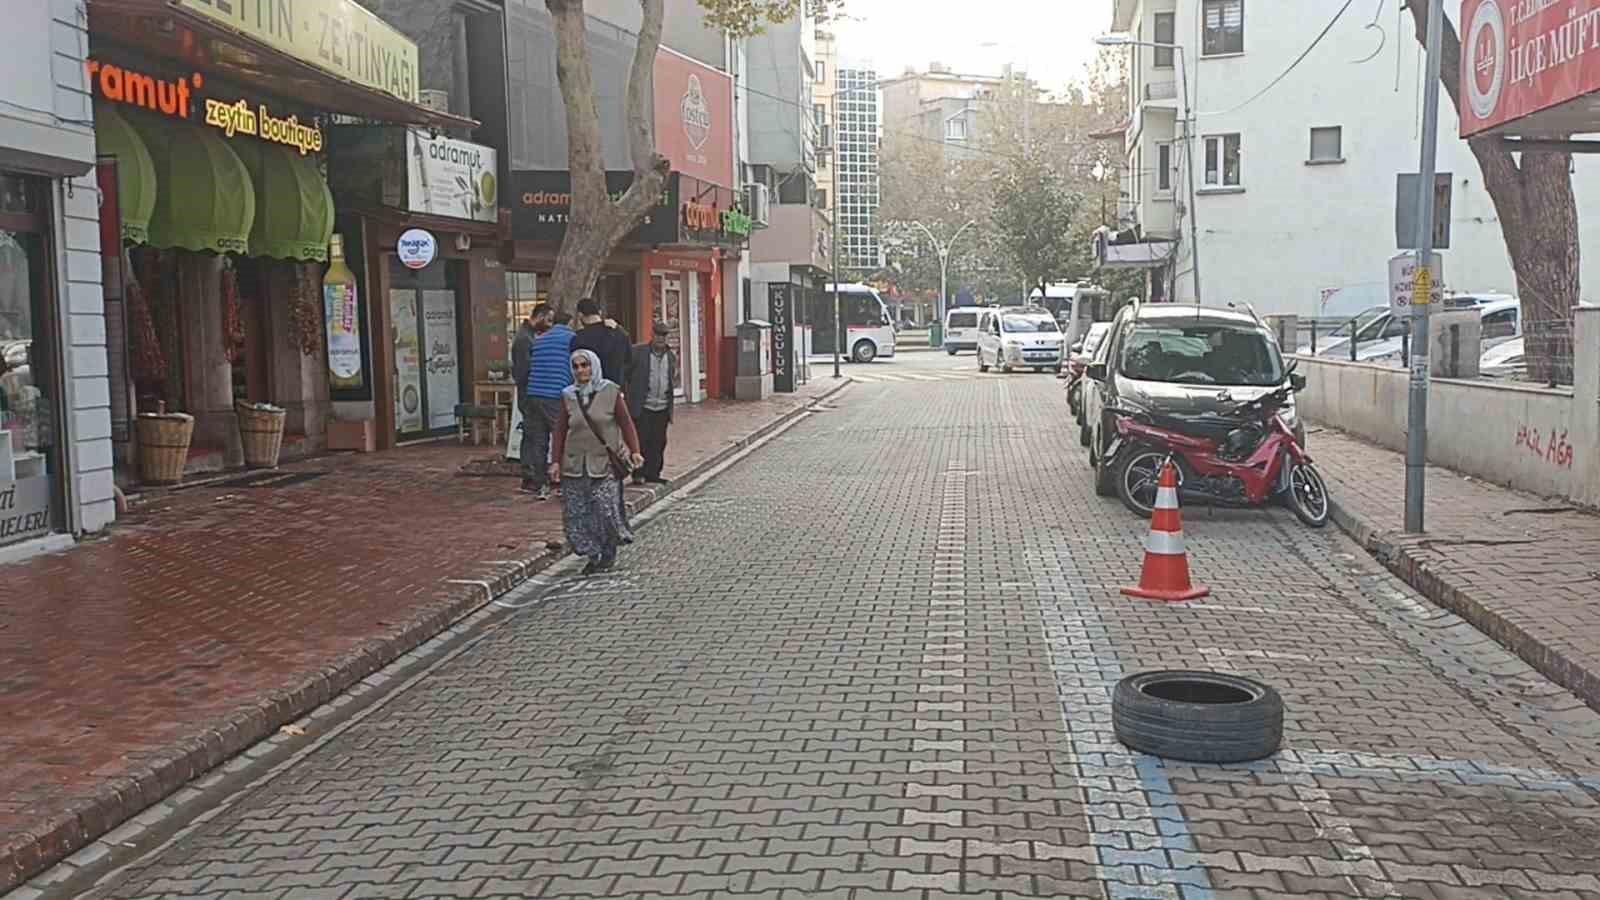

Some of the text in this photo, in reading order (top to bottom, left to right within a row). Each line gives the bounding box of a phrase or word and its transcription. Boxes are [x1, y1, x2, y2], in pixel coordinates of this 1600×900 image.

[1509, 36, 1546, 88] İLÇE
[205, 98, 322, 155] zeytin boutique
[429, 140, 482, 169] adramut
[522, 190, 570, 206] adram
[774, 290, 787, 376] KUYUMCULUK
